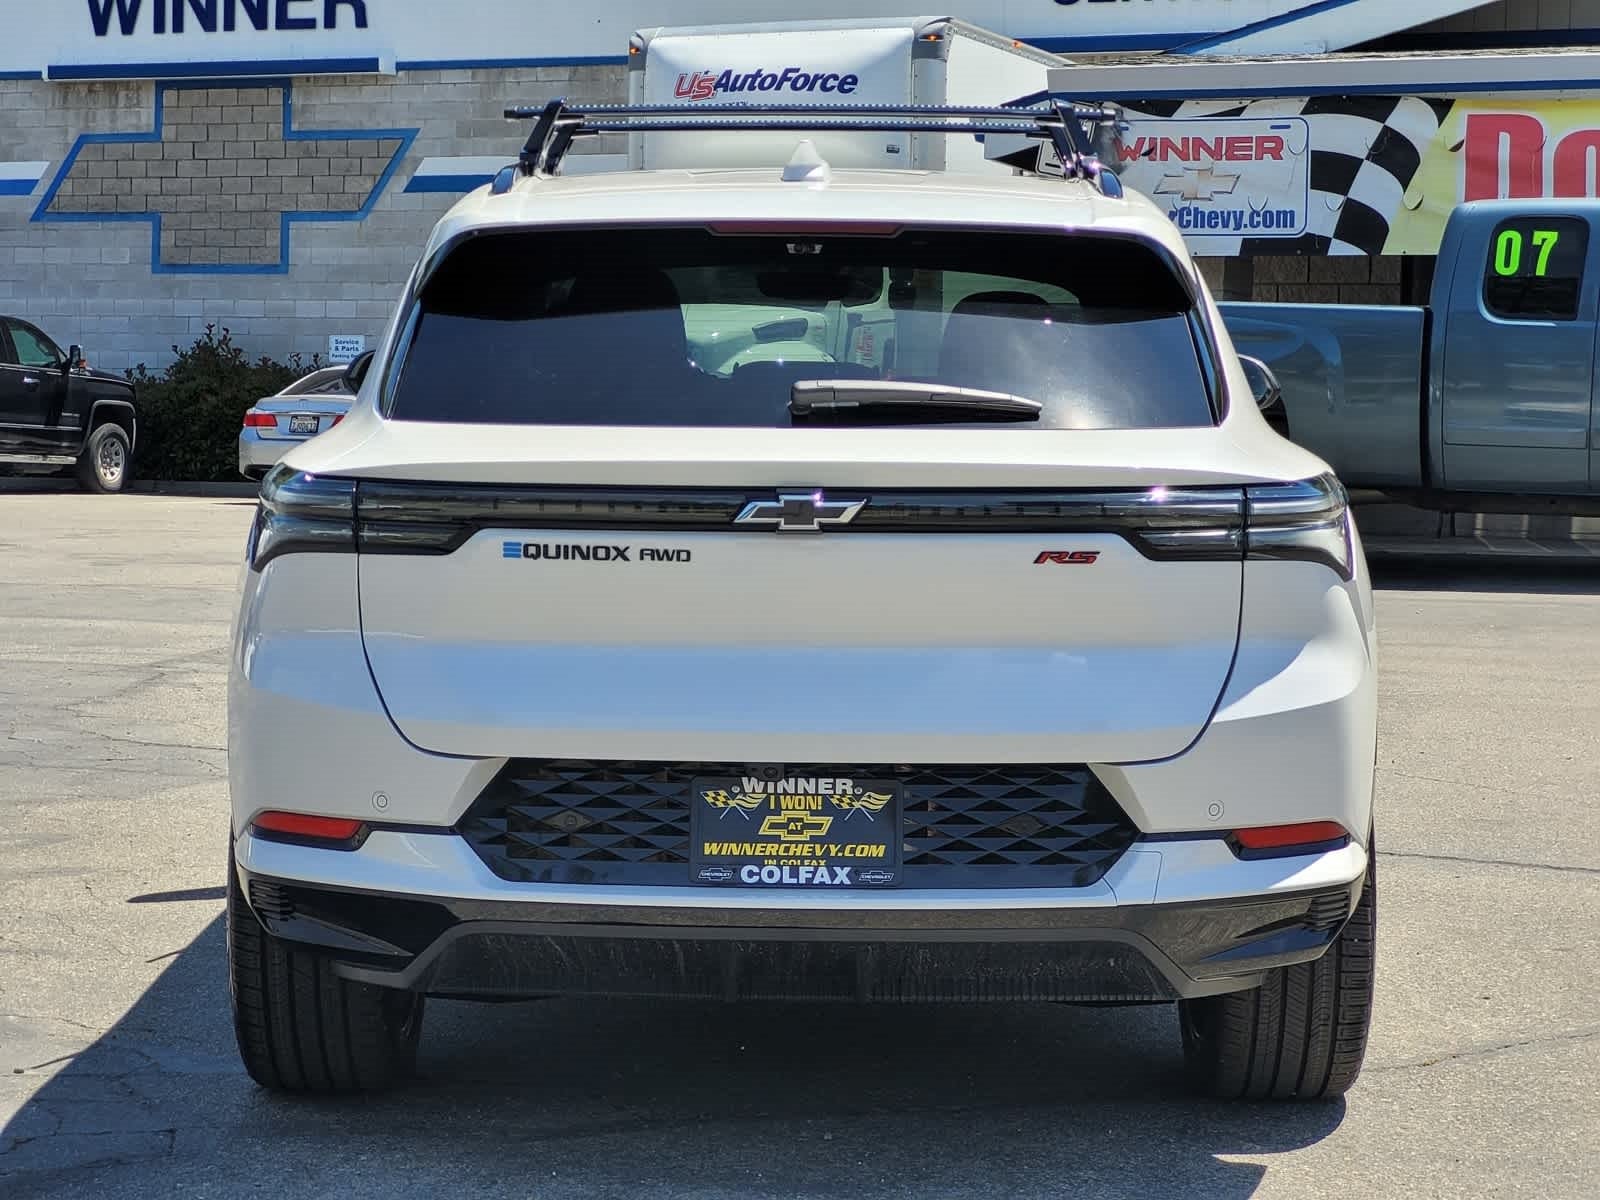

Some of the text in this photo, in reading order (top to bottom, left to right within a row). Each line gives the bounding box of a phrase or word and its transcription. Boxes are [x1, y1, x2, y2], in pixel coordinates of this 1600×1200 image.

[1113, 135, 1284, 162] WINNER
[502, 541, 692, 562] EQUINOX AWD
[1032, 551, 1101, 564] RS
[741, 777, 854, 794] WINNER
[770, 795, 823, 810] I WON!
[788, 822, 803, 831] AT
[703, 842, 886, 858] WINNERCHEVY.COM
[740, 864, 852, 885] COLFAX
